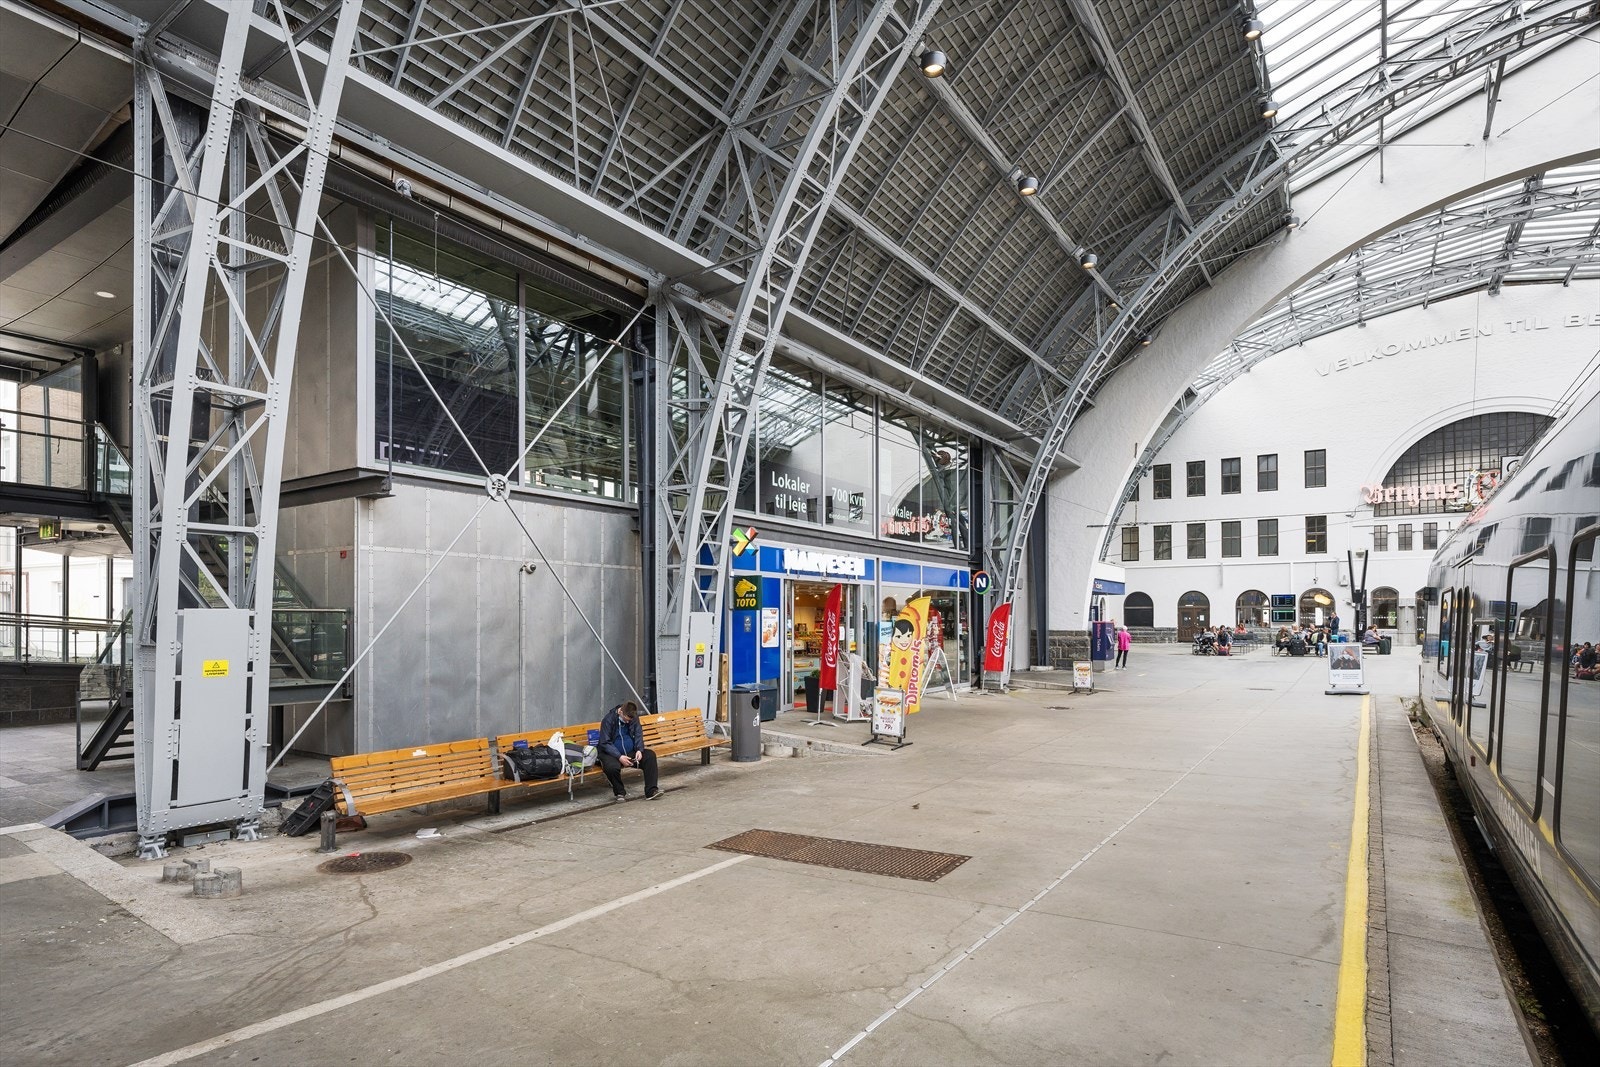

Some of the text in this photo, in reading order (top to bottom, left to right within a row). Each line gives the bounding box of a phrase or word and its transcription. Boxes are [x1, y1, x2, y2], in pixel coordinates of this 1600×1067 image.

[1314, 324, 1492, 376] VELKOMMEN
[1505, 317, 1549, 334] TIL
[772, 471, 811, 494] Lokaler
[775, 494, 808, 513] til leie
[832, 487, 867, 507] 700 kvm
[1360, 482, 1460, 507] Bergens
[887, 503, 913, 520] Lokaler
[736, 598, 757, 608] TOTO
